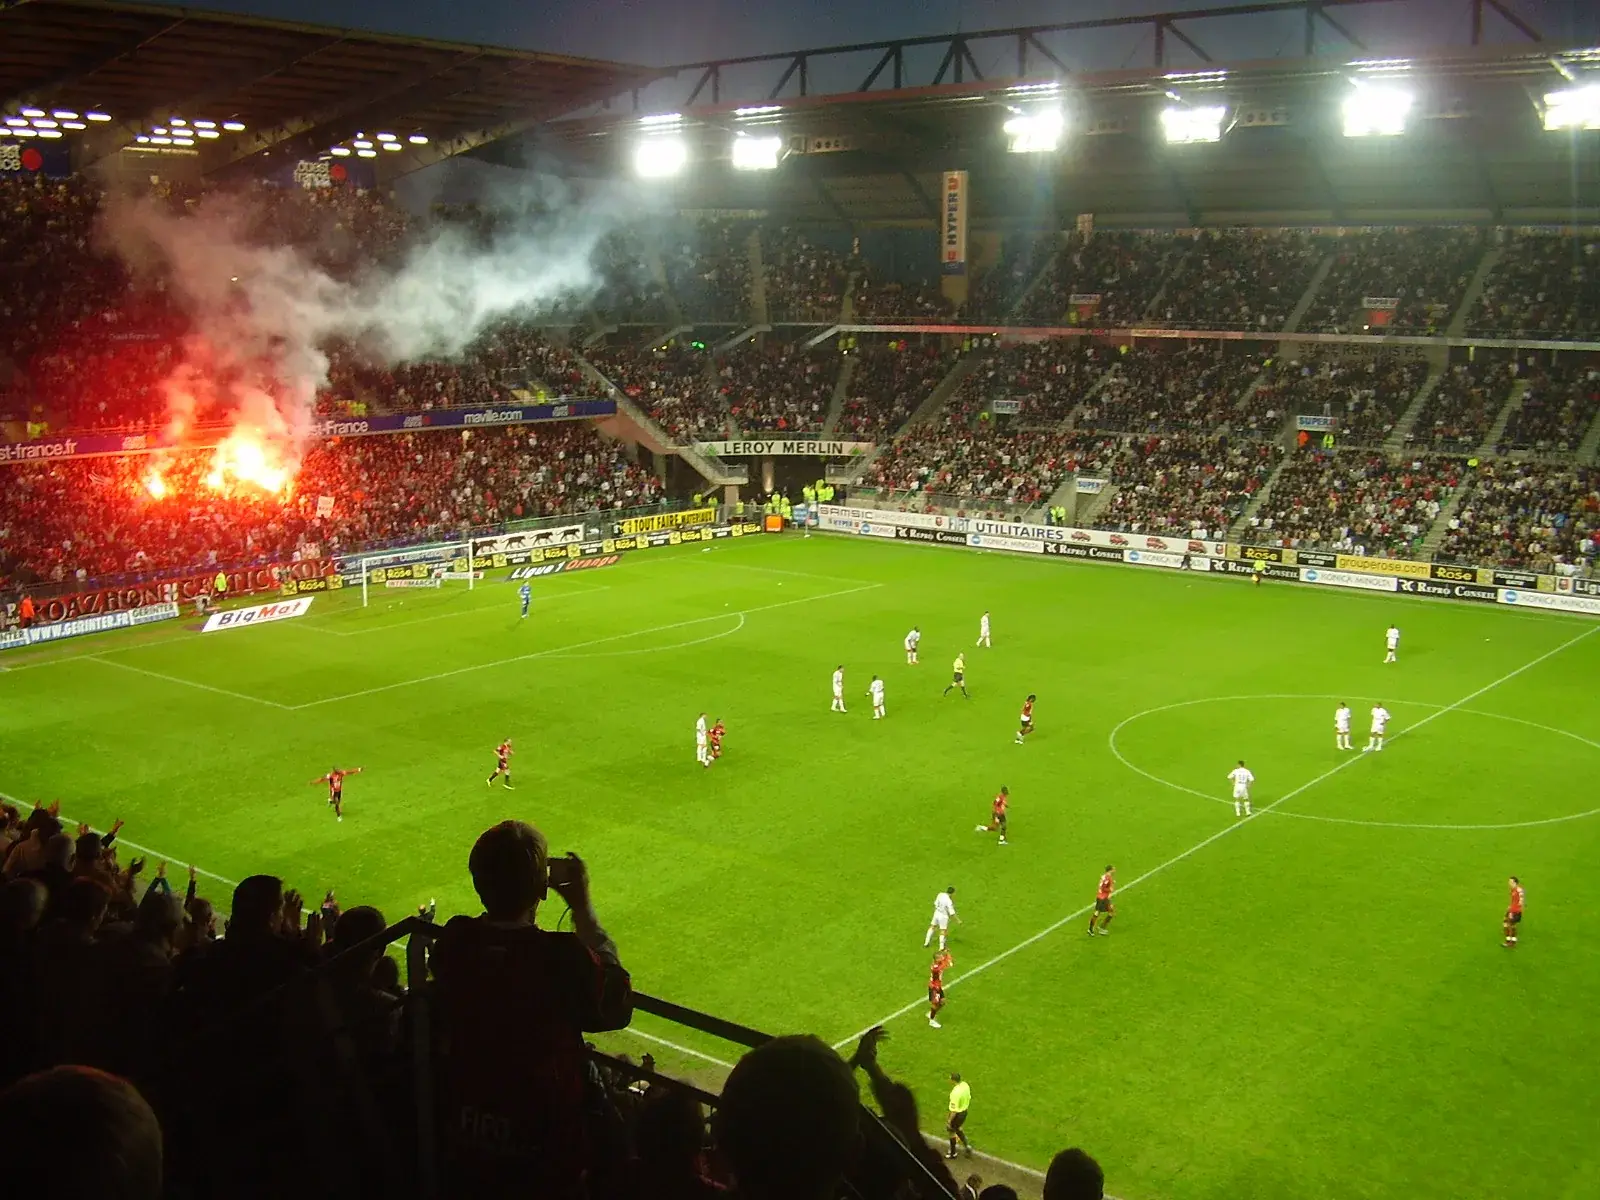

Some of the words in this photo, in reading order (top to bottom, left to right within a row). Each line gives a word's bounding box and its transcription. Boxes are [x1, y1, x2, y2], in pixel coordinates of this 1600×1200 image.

[464, 410, 523, 424] maville.com
[723, 441, 774, 455] LEROY
[783, 442, 843, 455] MERLIN
[819, 506, 873, 520] SAMSIC
[634, 517, 654, 532] TOUT
[976, 522, 1064, 540] UTILITAIRES
[511, 564, 554, 579] Ligue
[565, 554, 619, 571] Orange
[1339, 558, 1429, 575] grouperose.com
[218, 601, 302, 626] BigMat
[29, 612, 130, 641] WWW.GERINTER.FR
